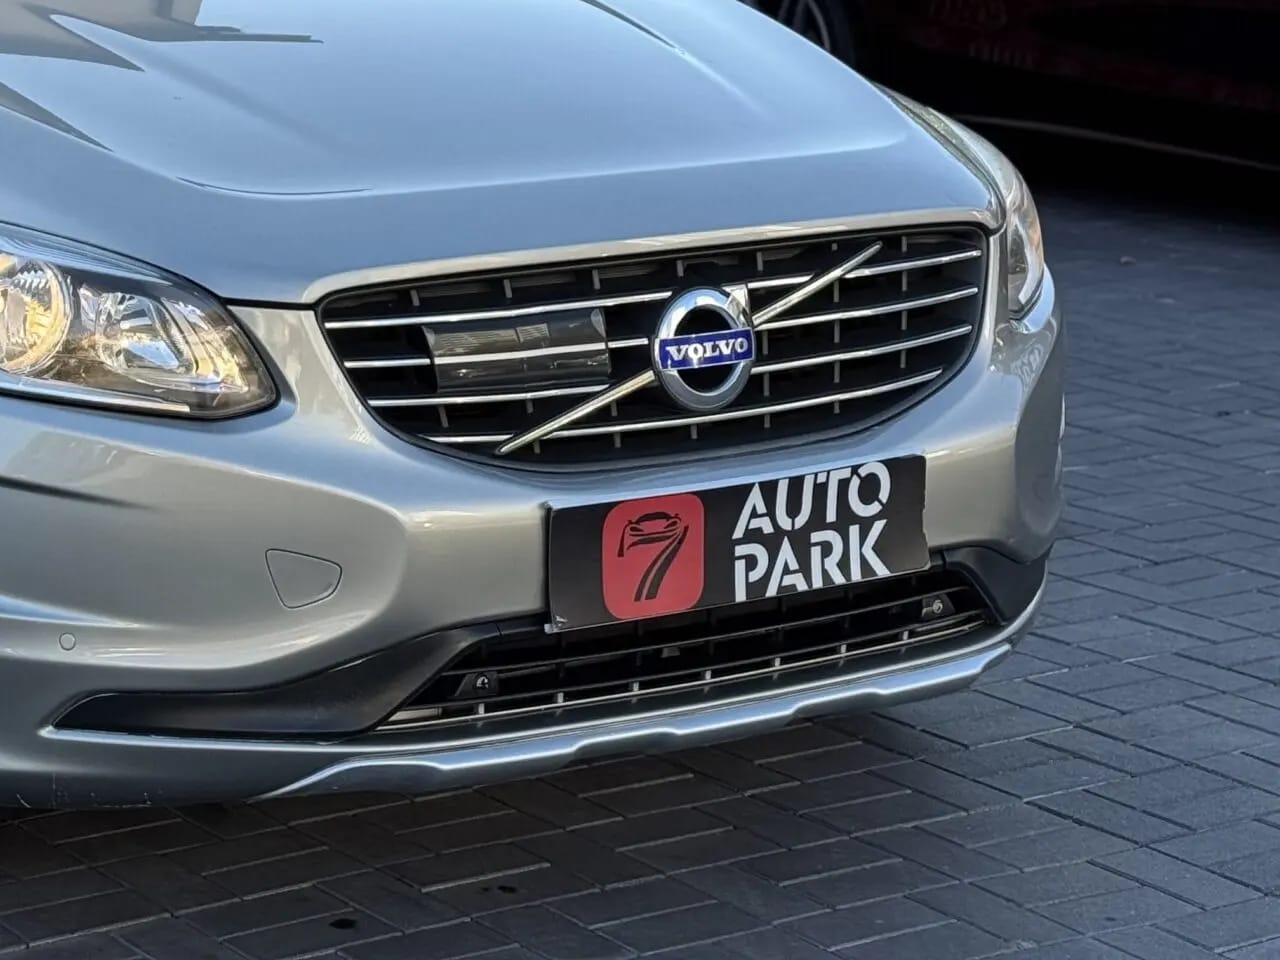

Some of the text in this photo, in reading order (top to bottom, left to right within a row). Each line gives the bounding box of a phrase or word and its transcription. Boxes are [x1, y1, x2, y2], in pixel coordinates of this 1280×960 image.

[665, 338, 749, 361] VOLVO
[732, 462, 892, 540] AUTO
[734, 518, 892, 603] PARK
